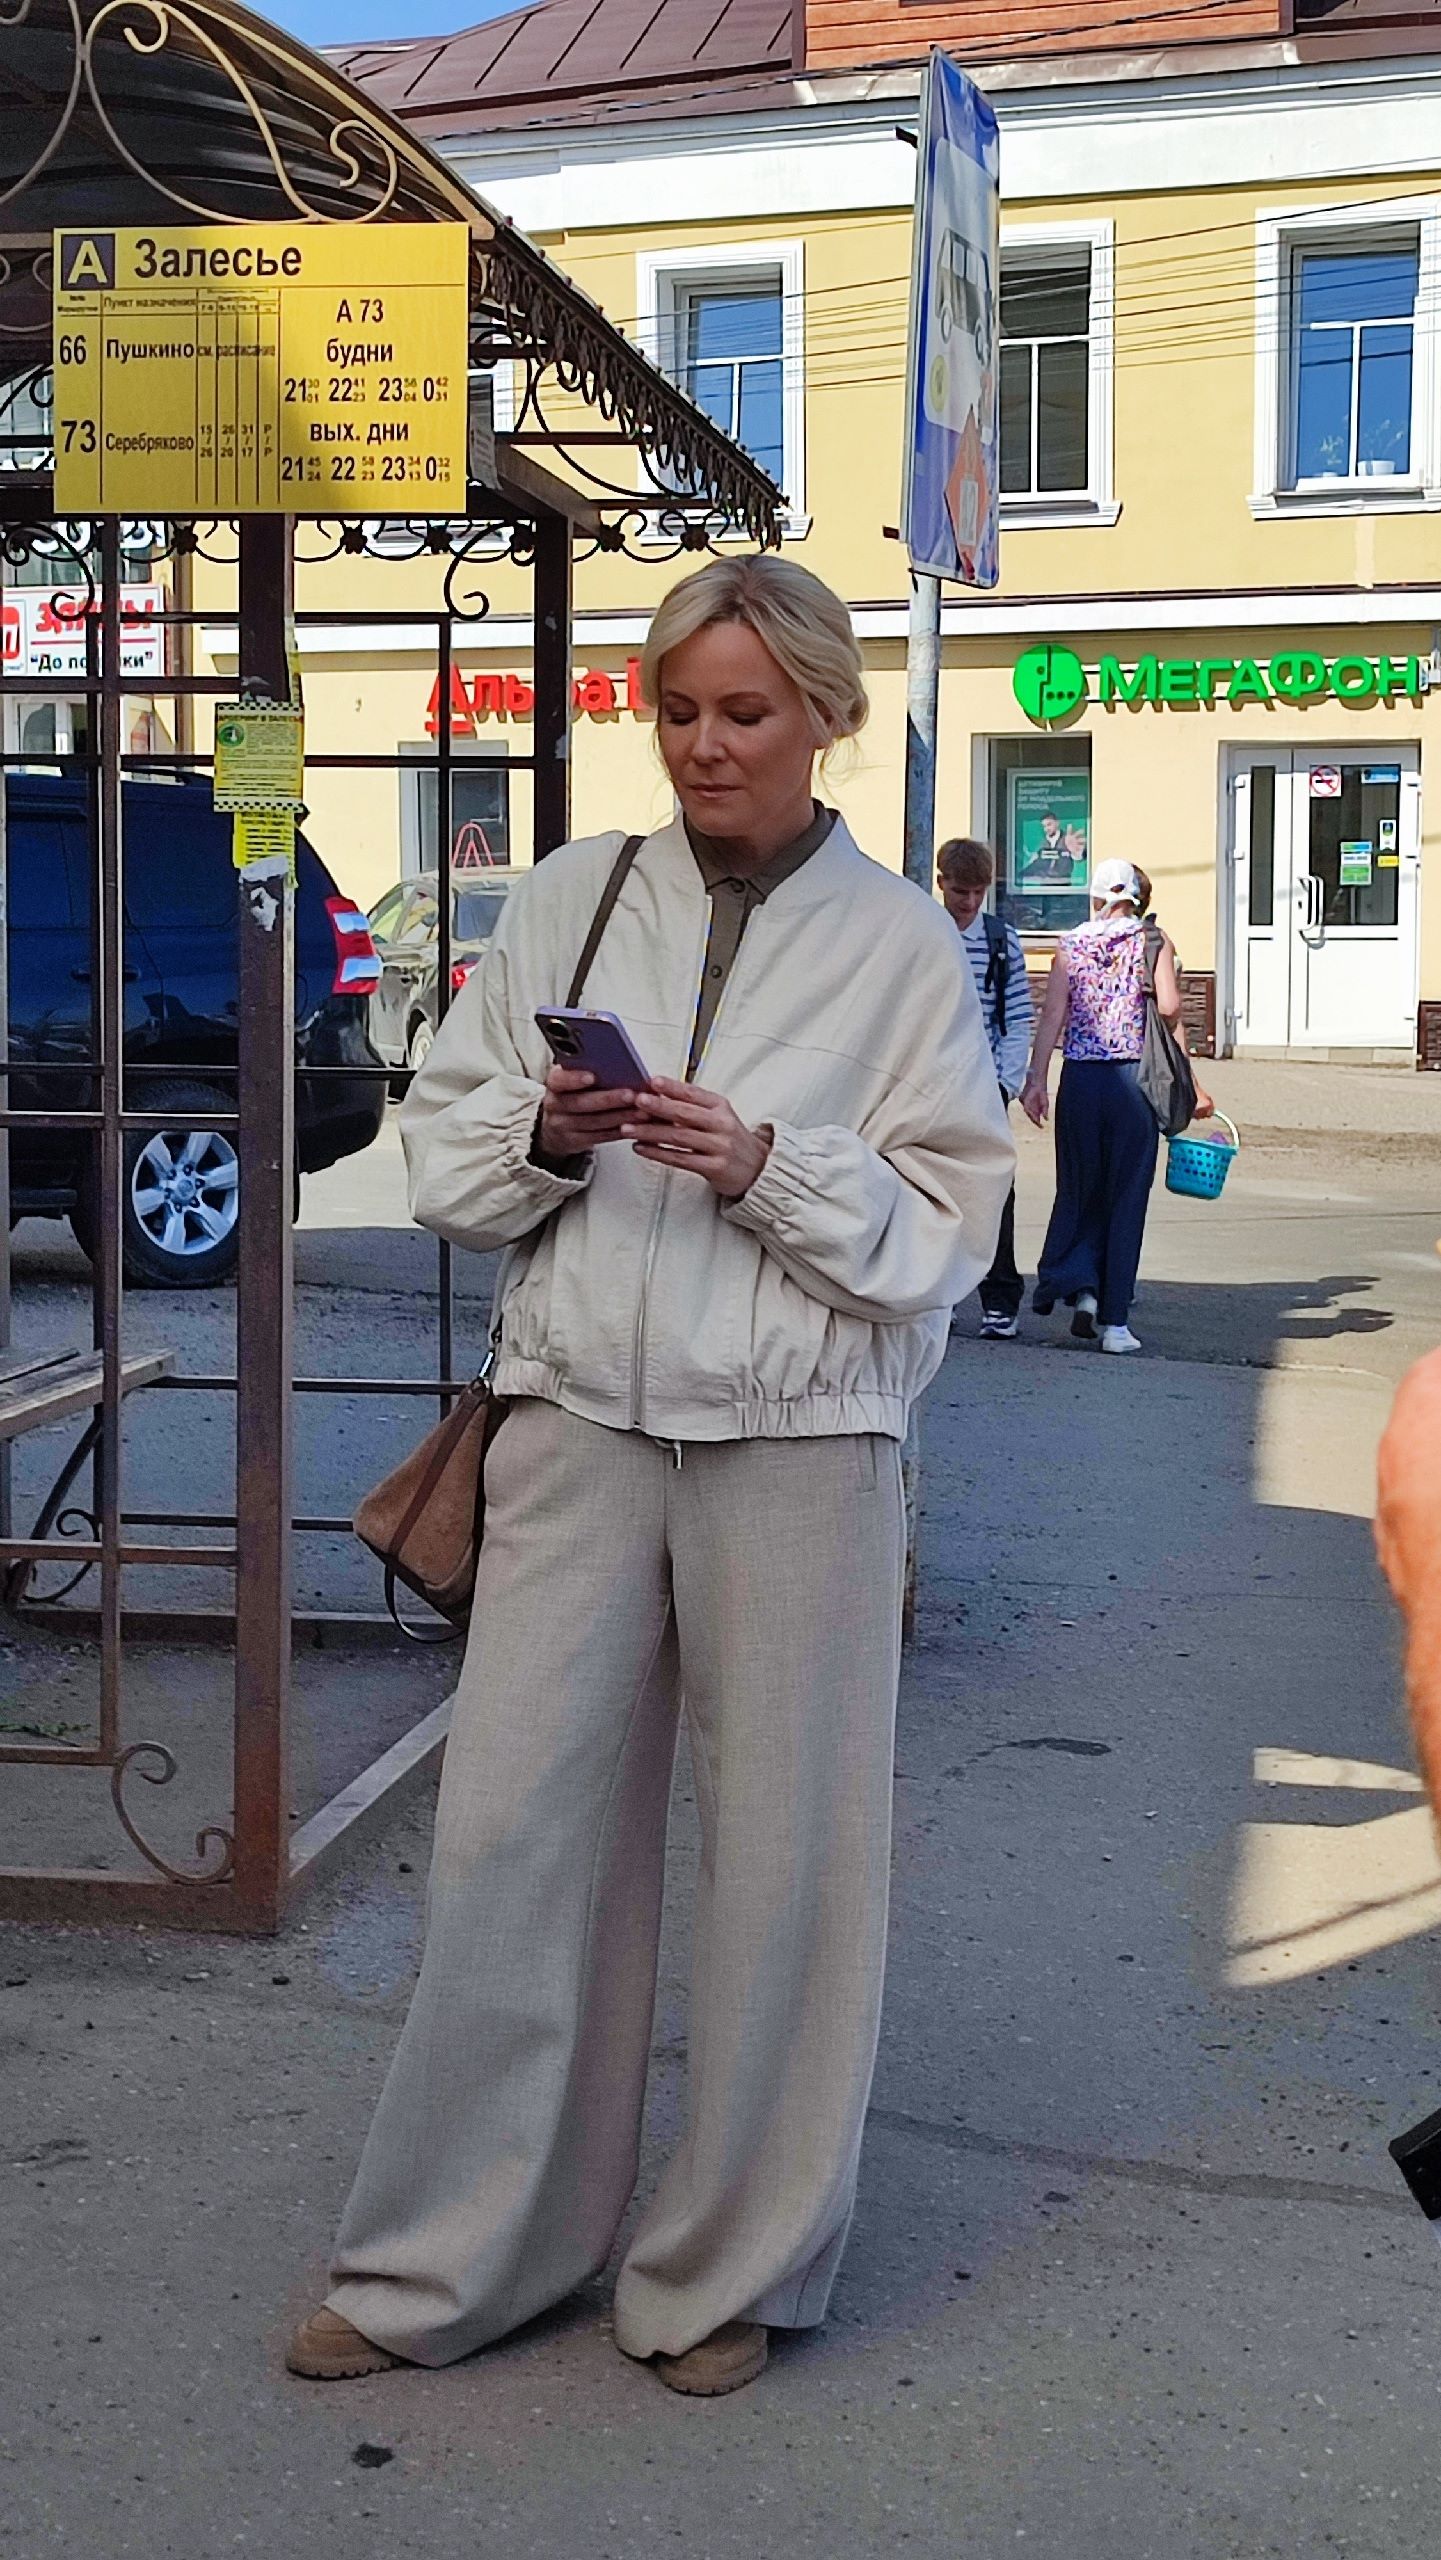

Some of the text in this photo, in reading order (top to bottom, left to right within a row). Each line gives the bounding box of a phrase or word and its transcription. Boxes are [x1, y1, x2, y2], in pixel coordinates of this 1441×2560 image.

[67, 238, 302, 284] А Залесье
[104, 296, 133, 310] Пункт
[337, 299, 384, 323] А 73
[59, 335, 87, 365] 66
[106, 339, 195, 363] Пушкино
[327, 337, 393, 369] будни
[284, 377, 435, 402] 21 22 23 0
[61, 420, 194, 453] 73 Серебряково
[310, 423, 409, 445] вых. дни
[282, 456, 437, 481] 21 22 23 0
[425, 662, 615, 733] Альа
